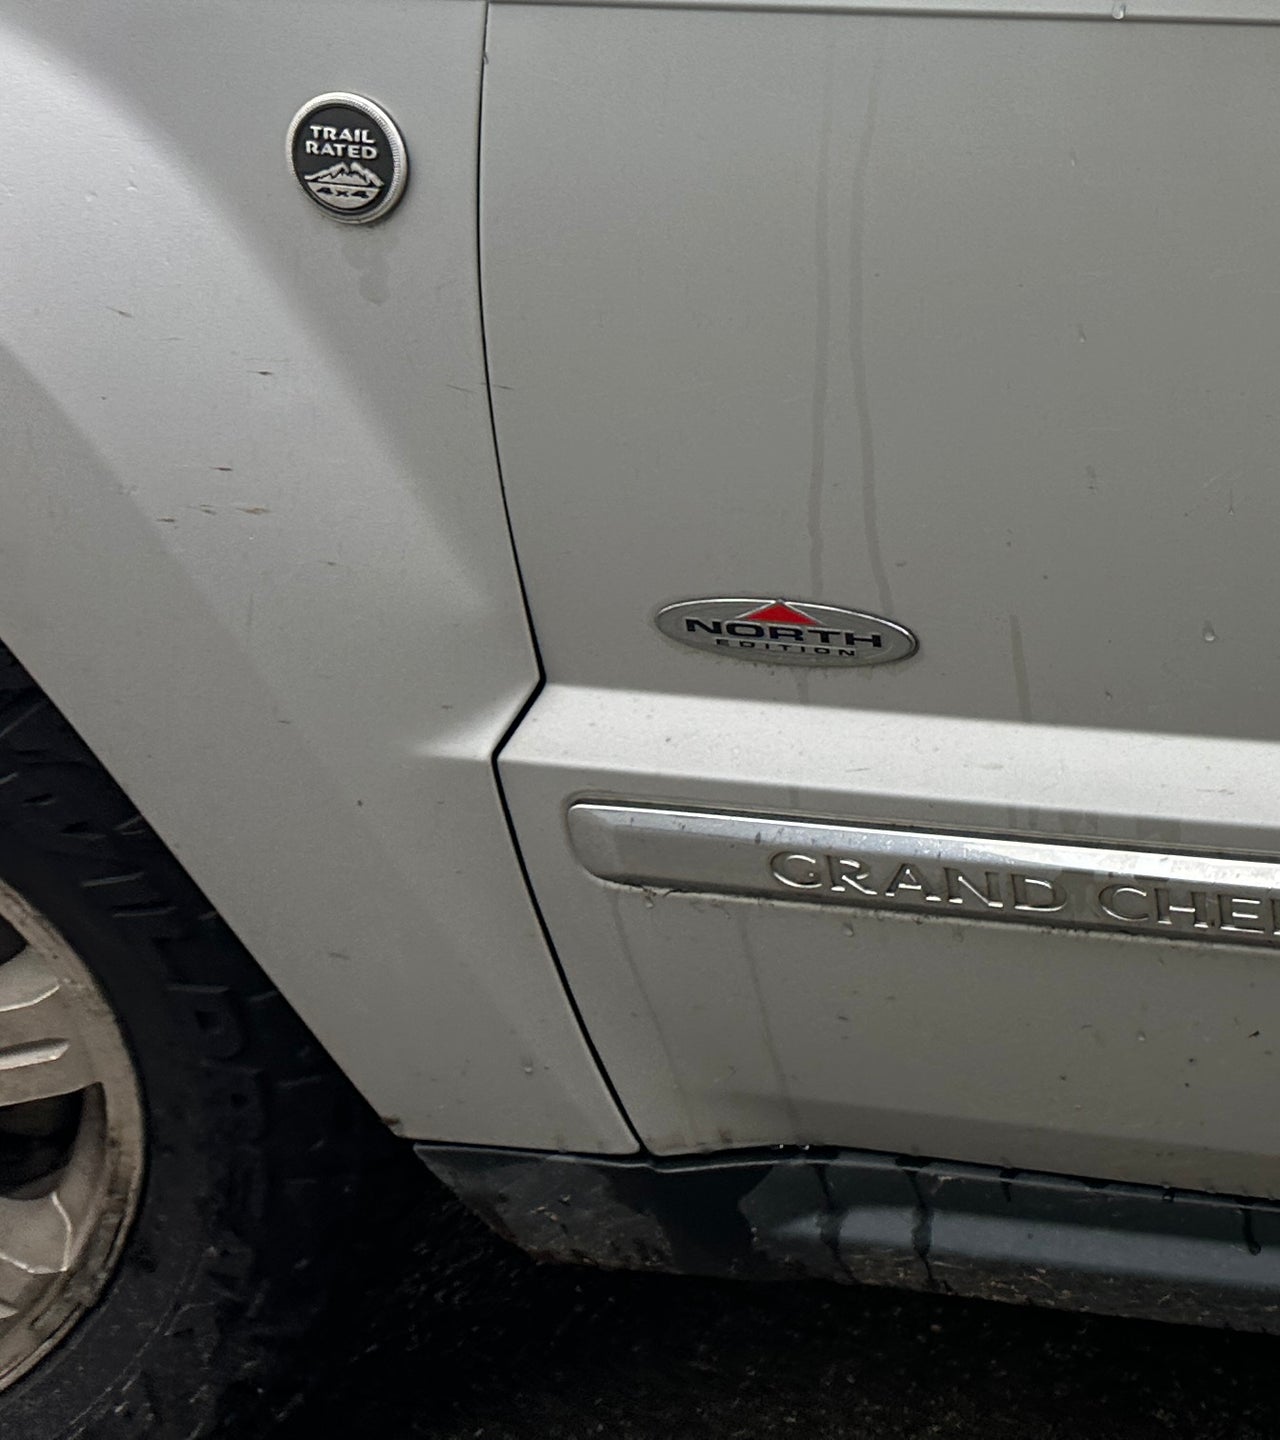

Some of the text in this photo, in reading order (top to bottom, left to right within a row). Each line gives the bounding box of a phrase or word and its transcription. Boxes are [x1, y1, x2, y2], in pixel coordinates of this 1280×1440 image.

[309, 125, 376, 144] TRAIL
[305, 140, 378, 160] RATED
[684, 618, 883, 649] NORTH
[715, 637, 856, 657] EDITION
[769, 851, 1068, 912] GRAND
